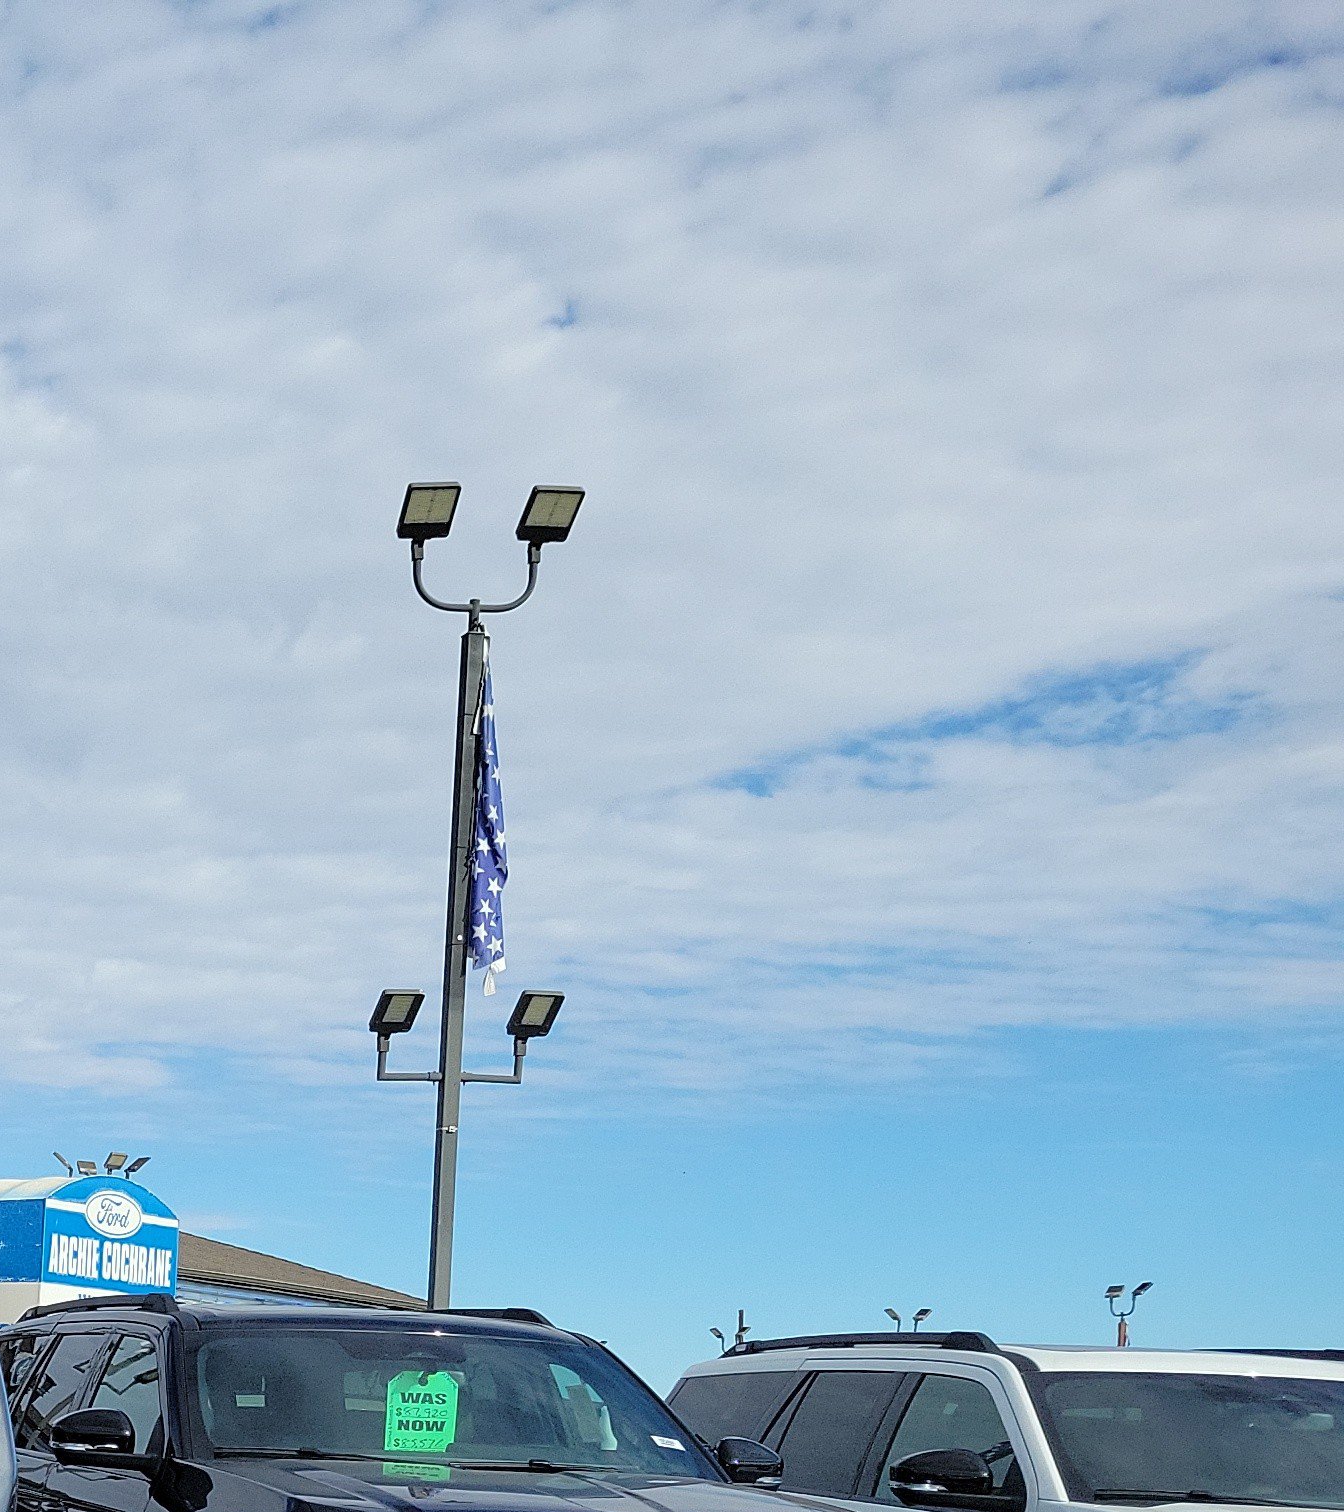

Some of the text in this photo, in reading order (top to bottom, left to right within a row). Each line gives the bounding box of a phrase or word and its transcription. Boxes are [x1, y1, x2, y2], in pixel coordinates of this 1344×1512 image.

[96, 1197, 131, 1229] Ford
[48, 1233, 173, 1288] ARCHIE COCHRANE
[400, 1392, 447, 1405] WAS
[397, 1419, 447, 1432] NOW
